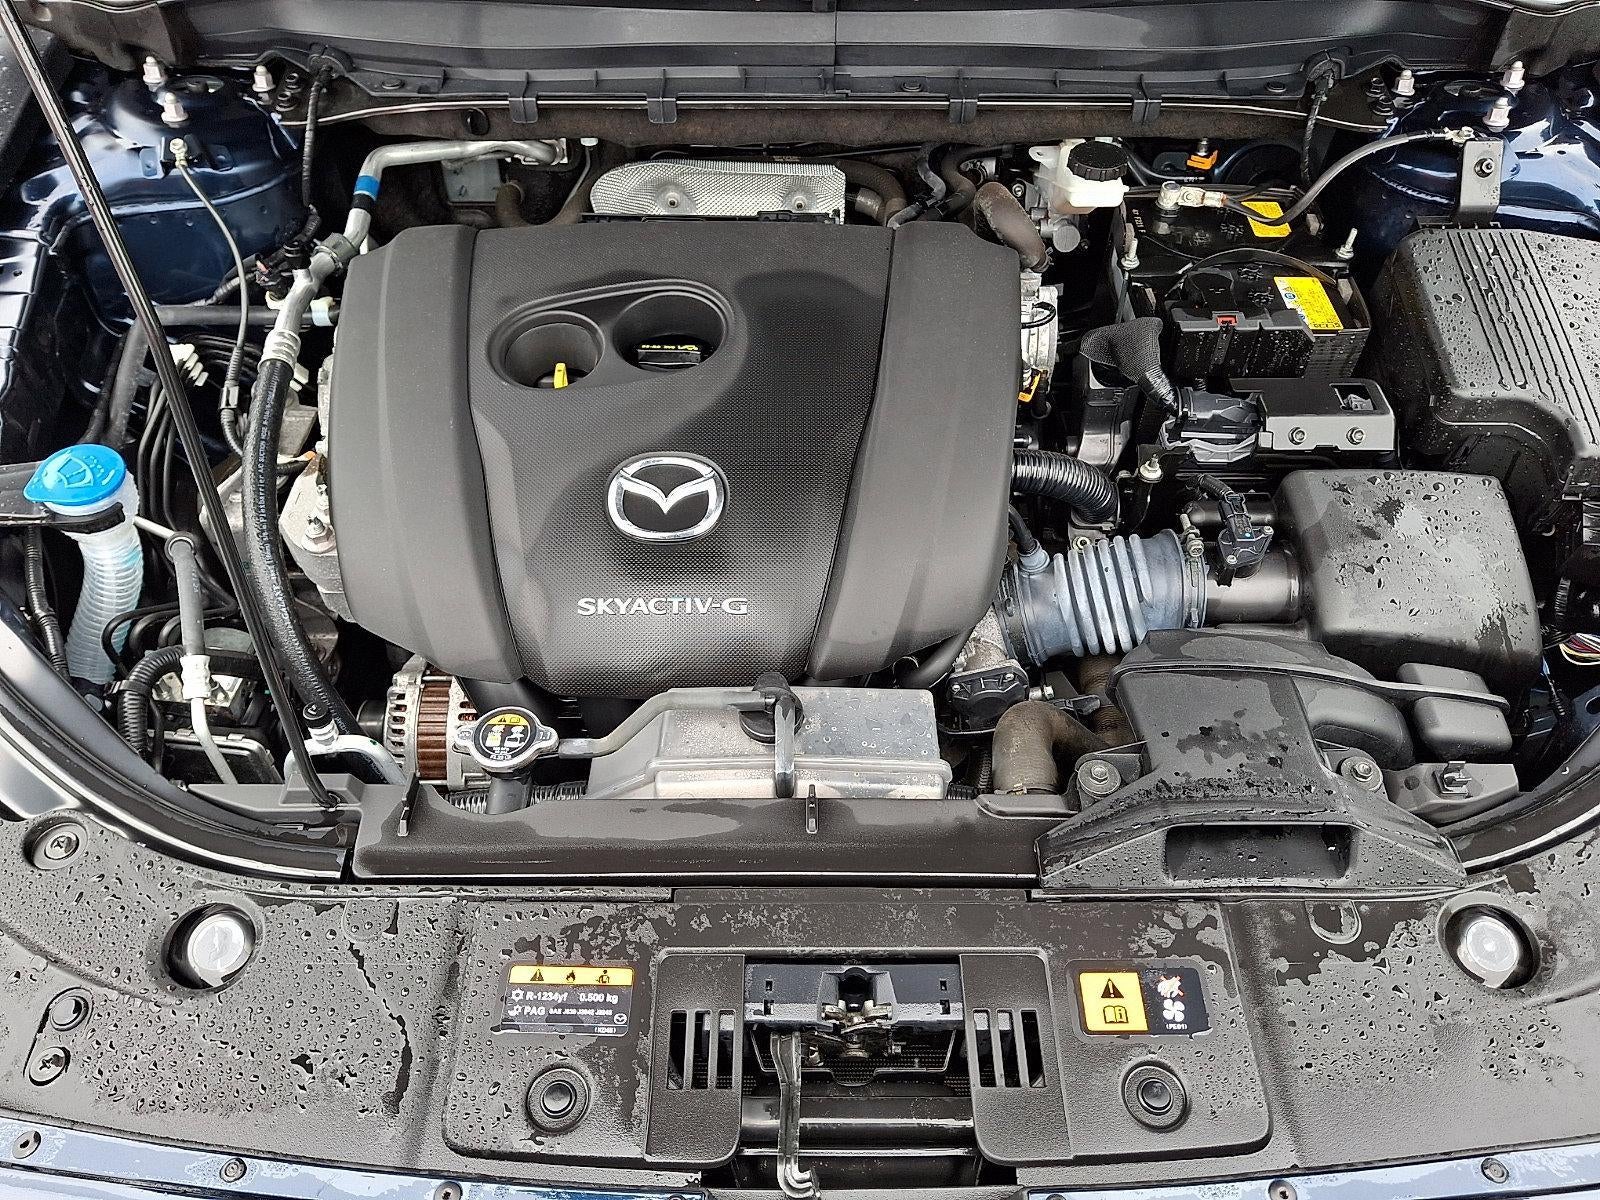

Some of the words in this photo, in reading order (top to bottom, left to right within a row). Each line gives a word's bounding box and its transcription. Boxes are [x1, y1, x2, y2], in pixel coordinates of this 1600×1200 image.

[577, 596, 748, 616] SKYACTIV-G
[525, 991, 568, 1003] R-1234yf
[579, 992, 605, 1002] 0.500
[605, 993, 619, 1004] kg
[523, 1006, 546, 1016] PAG
